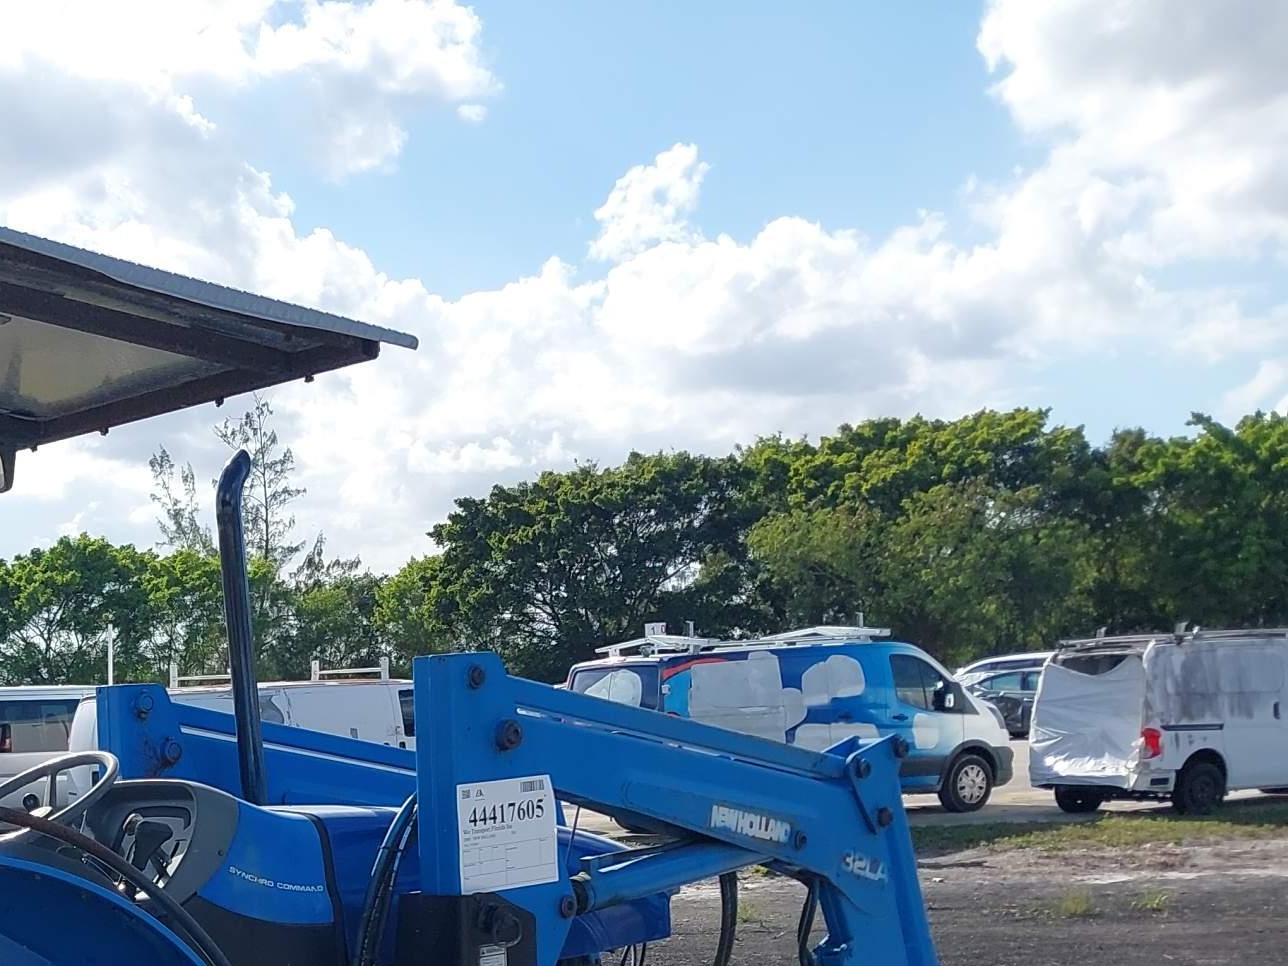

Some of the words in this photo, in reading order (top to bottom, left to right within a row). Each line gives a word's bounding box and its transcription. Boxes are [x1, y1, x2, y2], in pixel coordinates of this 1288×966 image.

[468, 799, 544, 827] 44417605
[711, 805, 737, 832] NEW
[737, 810, 791, 843] HOLLAND
[229, 866, 274, 887] SYNCHRO
[276, 882, 324, 893] COMMAND
